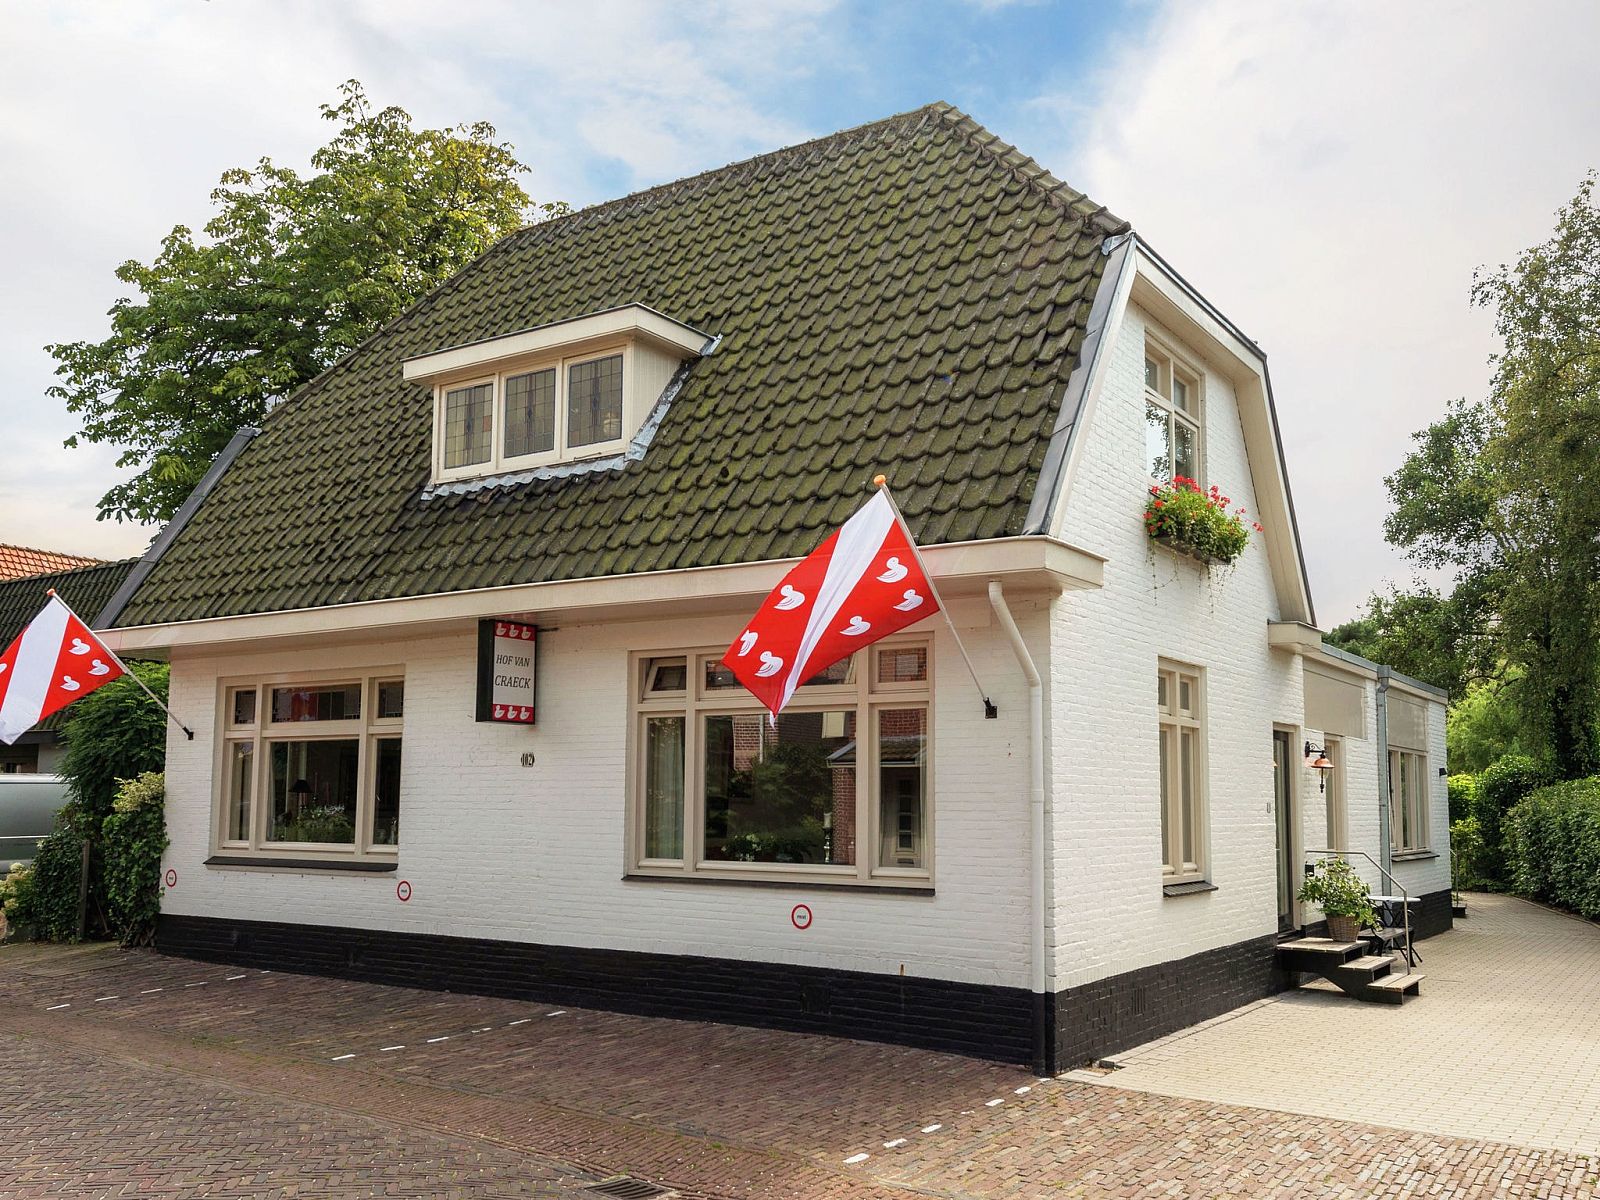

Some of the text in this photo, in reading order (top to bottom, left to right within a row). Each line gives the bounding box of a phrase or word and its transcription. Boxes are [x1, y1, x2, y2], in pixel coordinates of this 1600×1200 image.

[496, 654, 531, 668] HOF VAN
[494, 674, 532, 689] CRAECK
